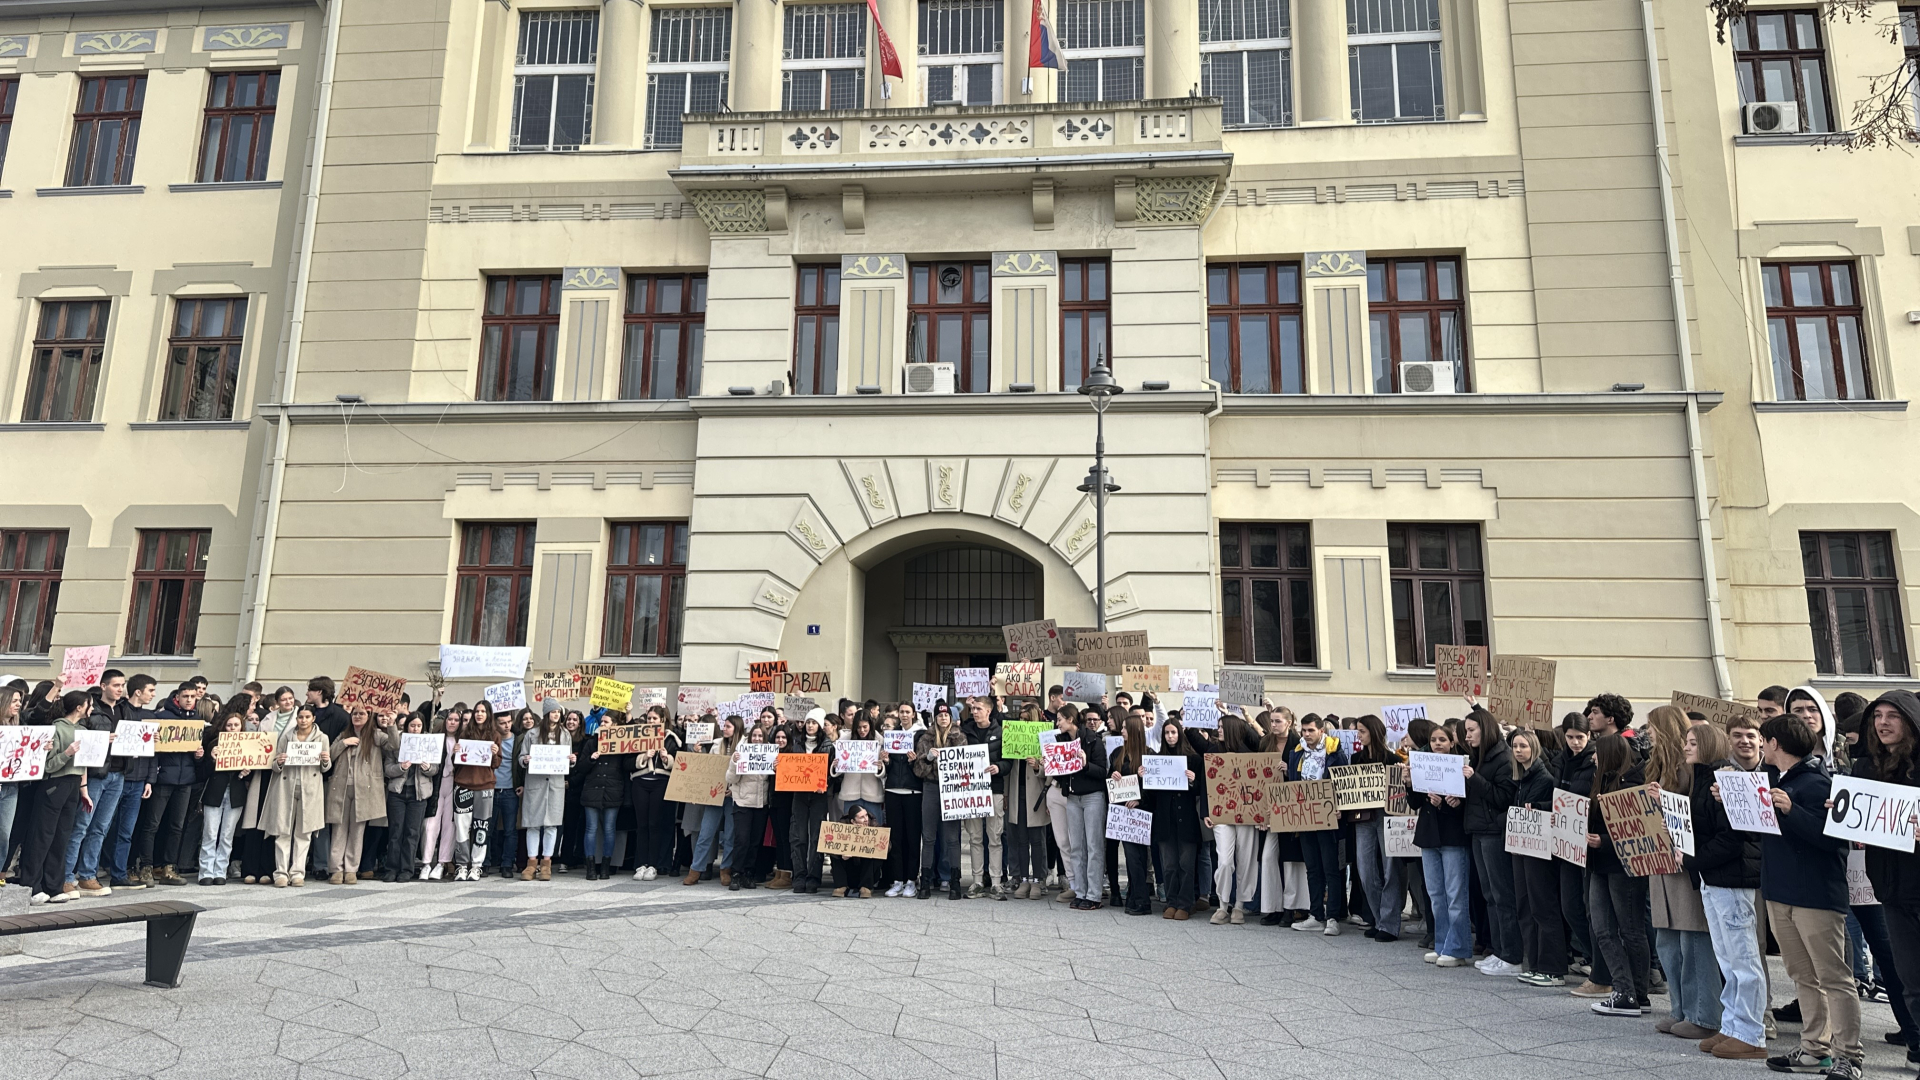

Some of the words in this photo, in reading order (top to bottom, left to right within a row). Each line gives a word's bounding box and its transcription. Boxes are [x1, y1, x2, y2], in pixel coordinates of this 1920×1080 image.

[1008, 623, 1047, 641] РУКЕ
[1077, 636, 1103, 652] САМО
[1106, 633, 1146, 650] СТУДЕНТ
[1109, 651, 1149, 667] СПАШАВА
[1438, 647, 1459, 662] РУКЕ
[1466, 648, 1481, 663] ИМ
[750, 661, 788, 679] МАМА
[995, 661, 1043, 675] БЛОКАДА
[1438, 662, 1479, 679] ОГРЕЗЛЕ
[1494, 659, 1517, 678] НИШТА
[1519, 661, 1537, 680] НИЈЕ
[1541, 662, 1557, 682] ВАМ
[773, 672, 831, 694] ПРАВДА
[1005, 673, 1021, 683] АКО
[1023, 673, 1032, 683] НЕ
[1221, 671, 1230, 681] 15
[1004, 682, 1042, 697] САДА?
[1449, 678, 1470, 694] КРВ
[1515, 680, 1531, 700] СВЕ
[1490, 697, 1513, 717] БРУТО
[1676, 693, 1719, 713] ИСТИНА
[1722, 702, 1736, 716] ЈЕ
[1185, 708, 1219, 722] БОРБОМ
[600, 726, 660, 740] ПРОТЕСТ
[1008, 723, 1027, 733] САМО
[219, 732, 262, 742] ПРОБУДИ
[403, 736, 436, 744] ИСТИНА
[218, 741, 242, 749] ЧУЛА
[218, 748, 243, 757] УГАСИ
[601, 741, 616, 754] ЈЕ
[620, 738, 660, 752] ИСПИТ
[216, 755, 271, 769] НЕПРАВДУ
[689, 754, 730, 767] МИСЛИ
[749, 753, 767, 762] ВИШЕ
[781, 755, 826, 766] ГИМНАЗИЈА
[1143, 757, 1173, 766] ПАМЕТАН
[1414, 753, 1448, 763] ОБРАЗОВАН
[737, 762, 748, 773] НЕ
[795, 765, 804, 773] ЈЕ
[948, 761, 974, 771] БРАНИ
[1144, 767, 1161, 776] ВИШЕ
[1331, 766, 1359, 778] МЛАДИ
[783, 775, 812, 785] УСТАЛА
[1107, 779, 1115, 790] 15
[1144, 776, 1154, 786] НЕ
[1333, 777, 1357, 792] МЛАДИ
[1717, 775, 1750, 793] ХЛЕБА
[1240, 785, 1254, 806] 15
[1268, 784, 1291, 805] КАМО
[1336, 791, 1361, 806] МЛАДИ
[943, 794, 992, 811] БЛОКАДА
[1603, 791, 1642, 821] УЧИМО
[1638, 789, 1660, 816] ДА
[1280, 800, 1335, 828] РОЂАЧЕ?
[1507, 807, 1542, 823] СРБИЈОМ
[1728, 808, 1755, 826] МНОГО
[1831, 788, 1915, 840] OSTAVKA
[1407, 818, 1415, 830] 15
[1554, 812, 1567, 829] ДА
[1573, 819, 1584, 836] СЕ
[1609, 817, 1646, 843] БИСМО
[1683, 818, 1692, 834] NE
[1615, 835, 1657, 860] ОСТАЛИ
